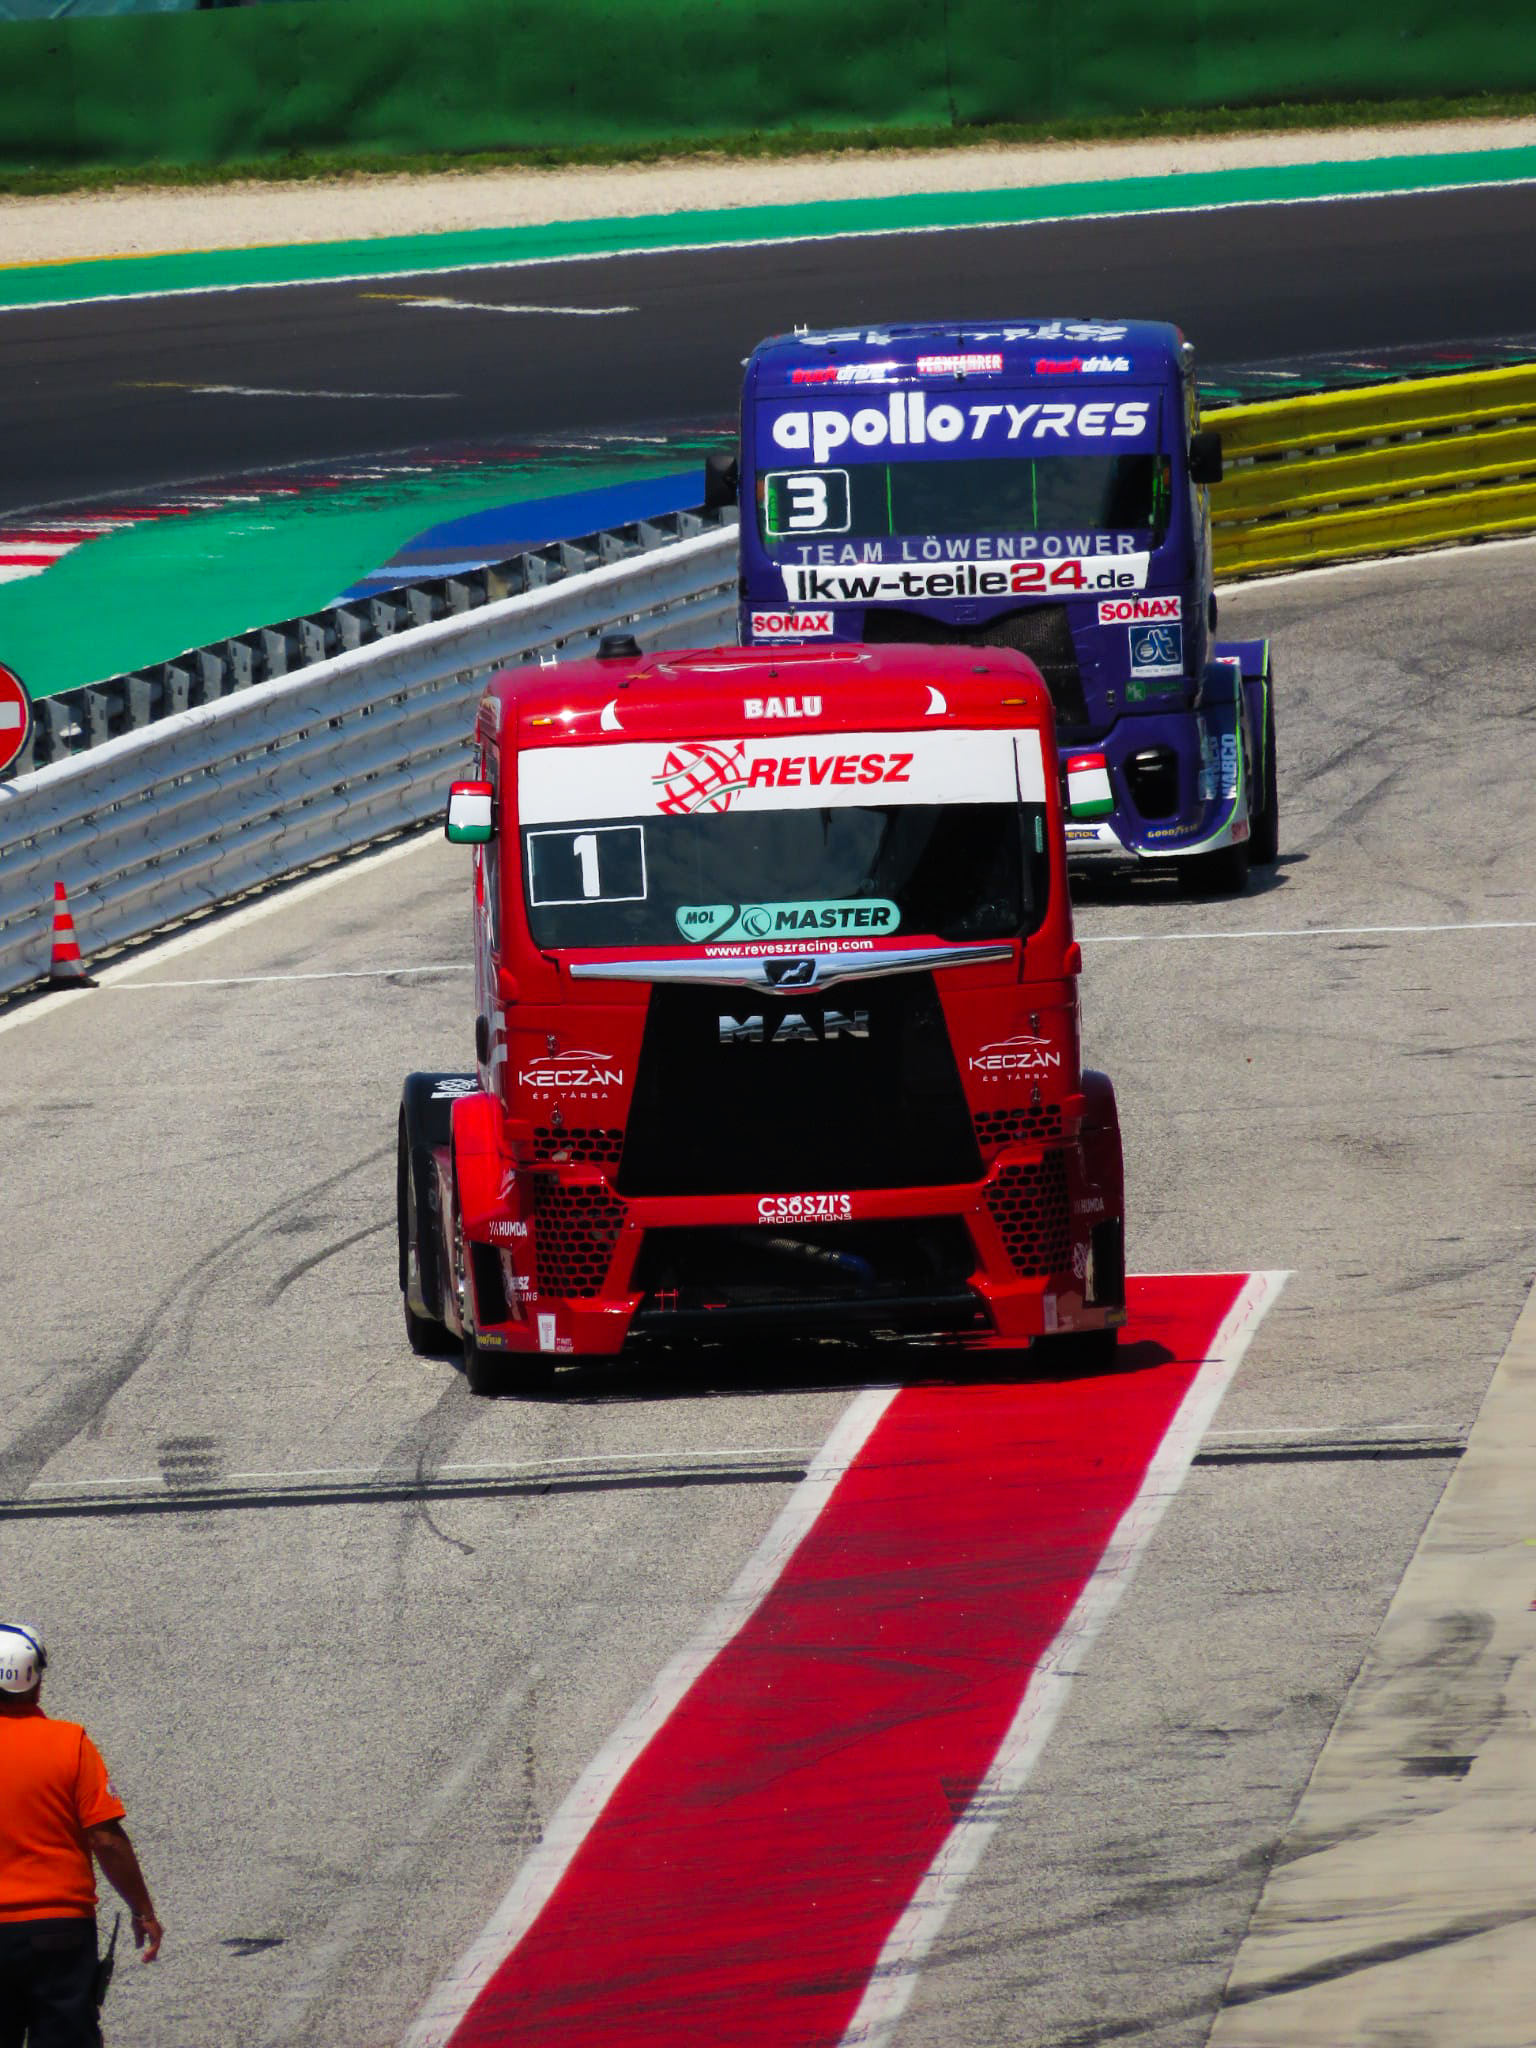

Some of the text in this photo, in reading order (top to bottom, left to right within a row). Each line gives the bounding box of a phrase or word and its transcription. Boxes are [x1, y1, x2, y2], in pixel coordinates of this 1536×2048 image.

[772, 392, 1150, 464] apollo TYRES
[786, 476, 829, 528] 3
[797, 534, 1136, 566] TEAM LÖWENPOWER
[797, 559, 1136, 601] lkw-teile24.de
[1100, 598, 1179, 622] SONAX
[753, 612, 830, 633] SONAX
[743, 695, 823, 719] BALU
[573, 834, 600, 897] 1
[685, 907, 891, 930] MOL MASTER
[705, 940, 874, 957] www.reveszracing.com
[718, 1010, 870, 1043] MAN
[758, 1213, 852, 1225] PRODUCTIONS
[0, 1668, 19, 1680] 101
